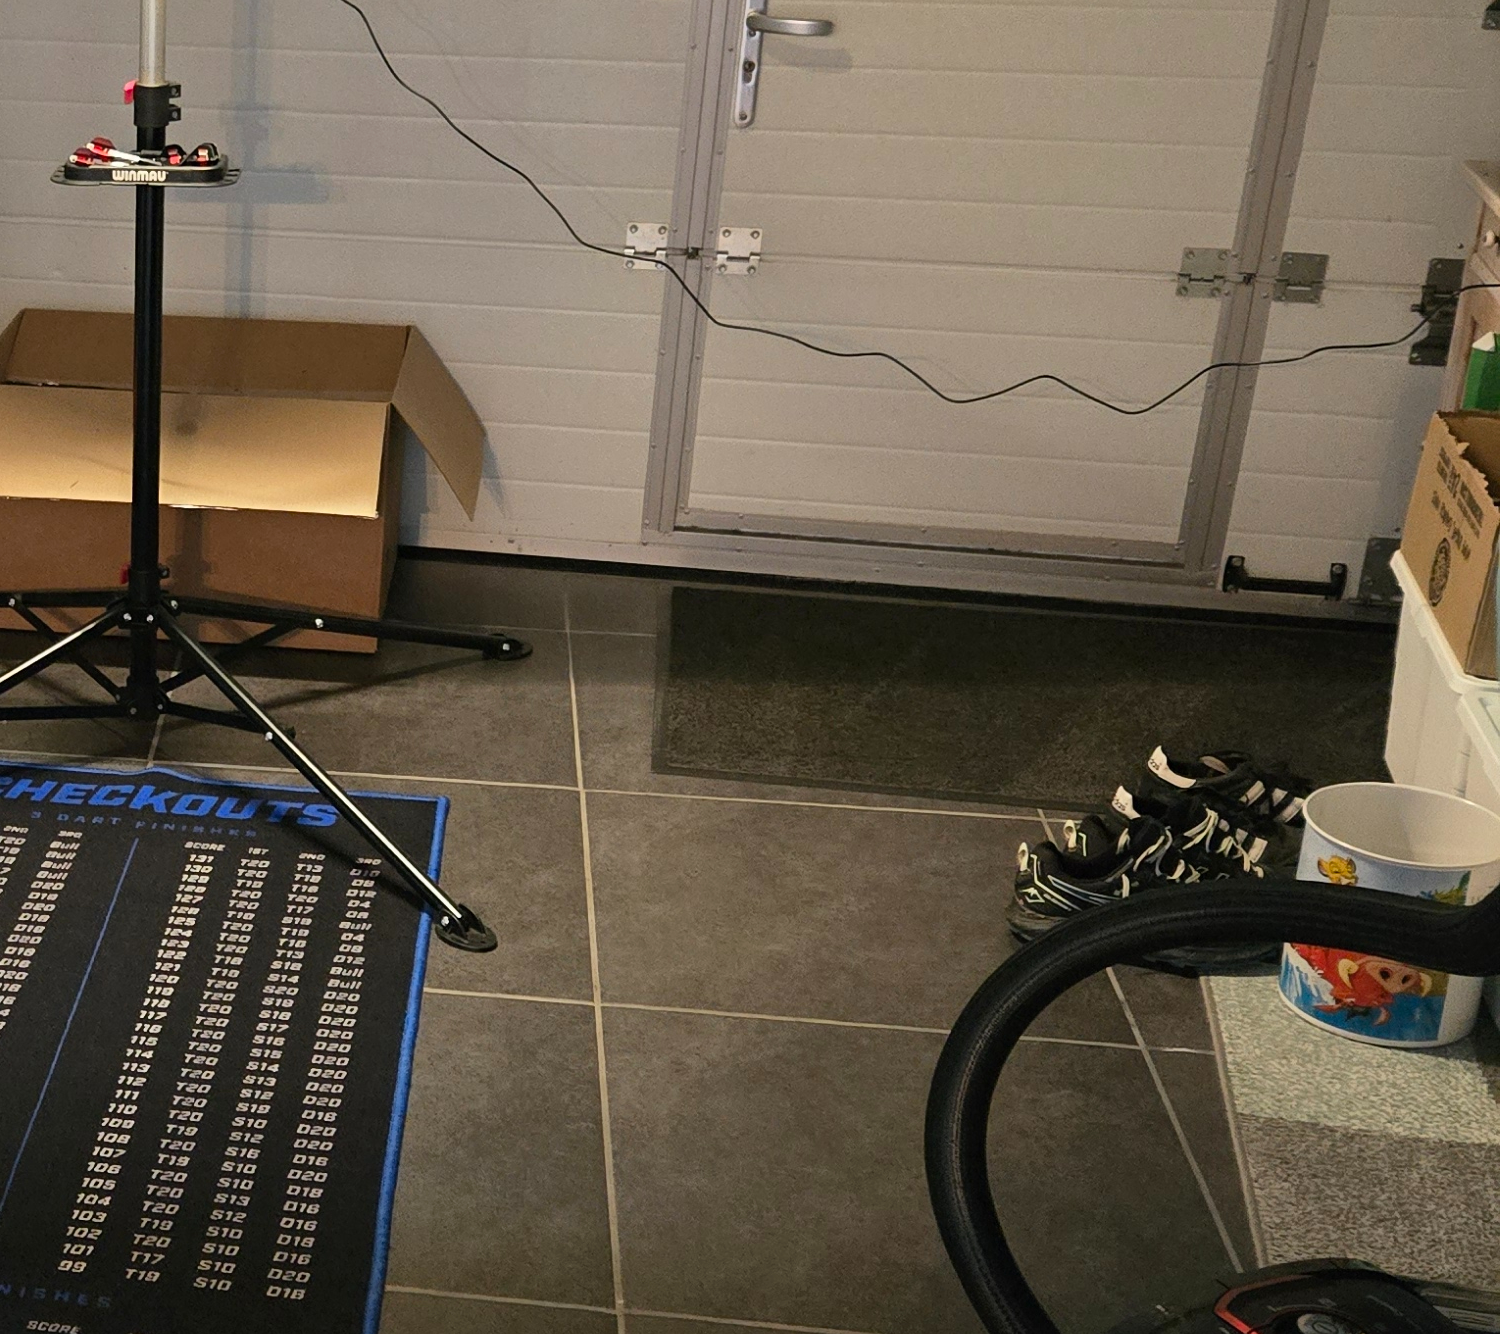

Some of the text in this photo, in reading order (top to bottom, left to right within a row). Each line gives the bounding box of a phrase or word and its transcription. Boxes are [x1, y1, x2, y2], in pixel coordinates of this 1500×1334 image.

[112, 170, 167, 182] WINMAU
[57, 813, 121, 826] DART
[26, 1320, 79, 1334] SCORE
